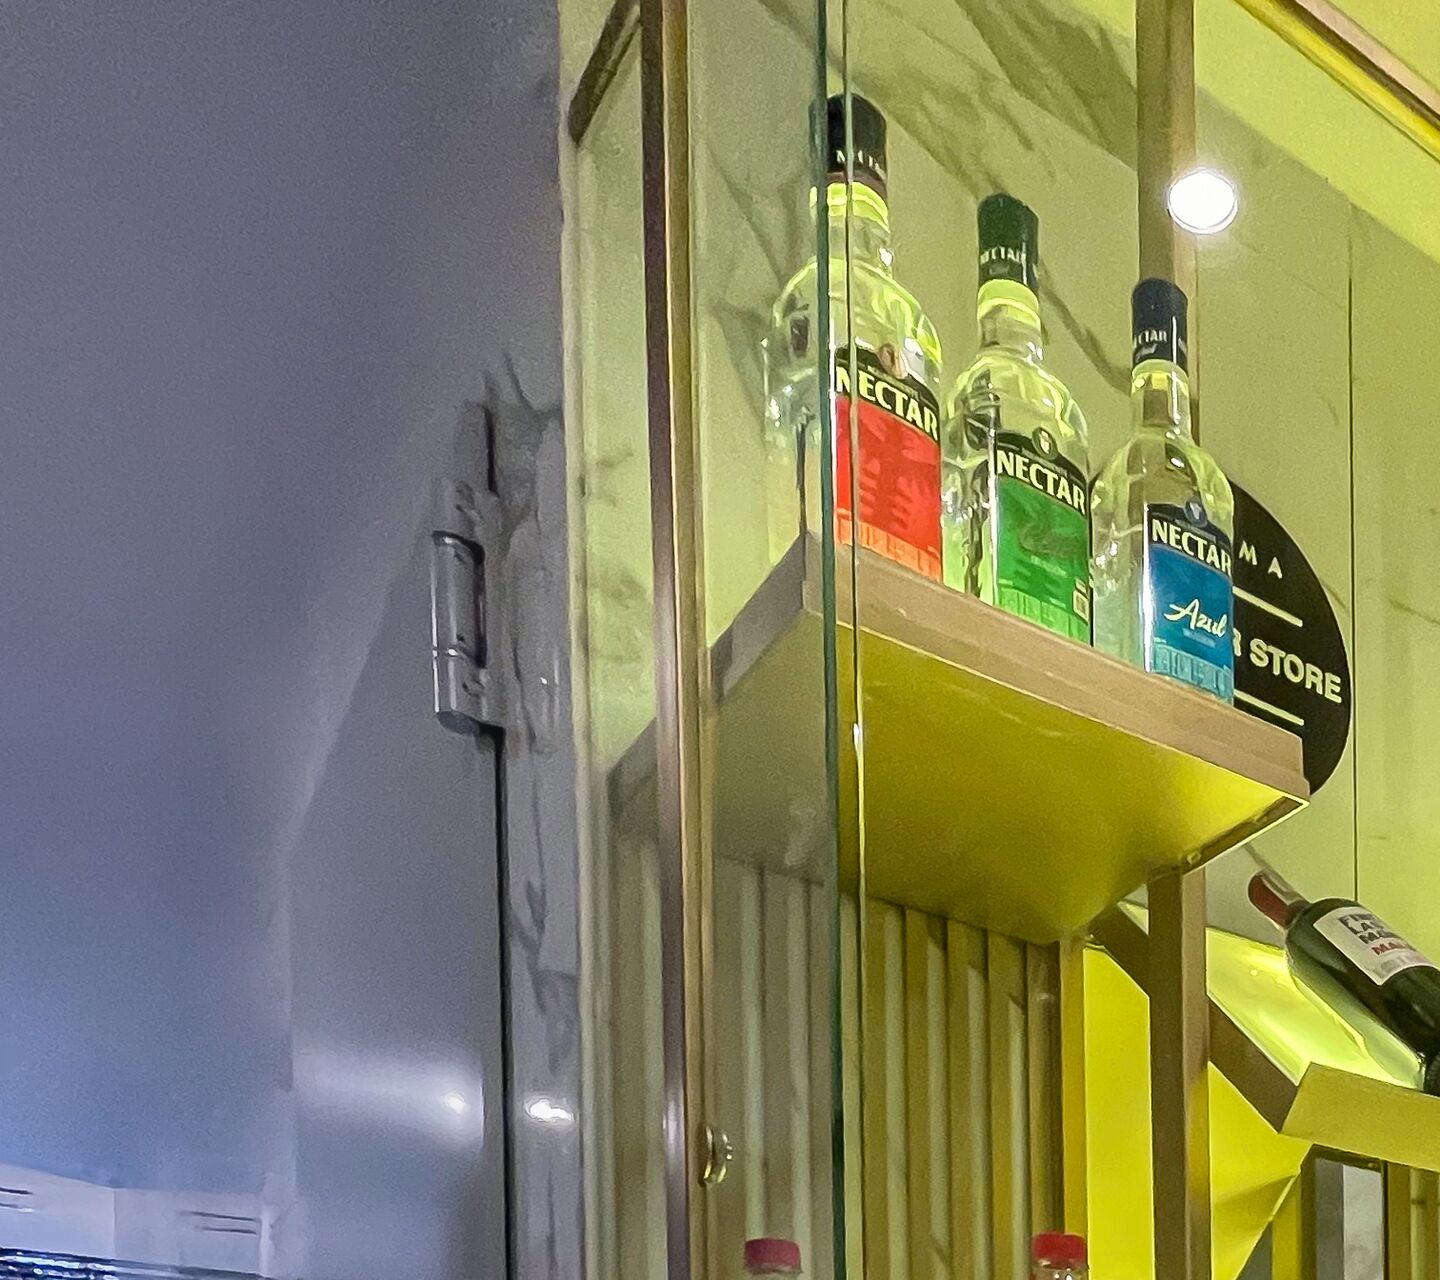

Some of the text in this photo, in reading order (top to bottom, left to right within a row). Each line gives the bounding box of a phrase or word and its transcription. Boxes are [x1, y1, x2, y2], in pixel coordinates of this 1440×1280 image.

[835, 366, 939, 441] NECTAR
[996, 449, 1086, 516] NECTAR
[1152, 519, 1232, 577] NECTAR
[1163, 598, 1228, 638] Azul
[1249, 637, 1343, 704] STORE
